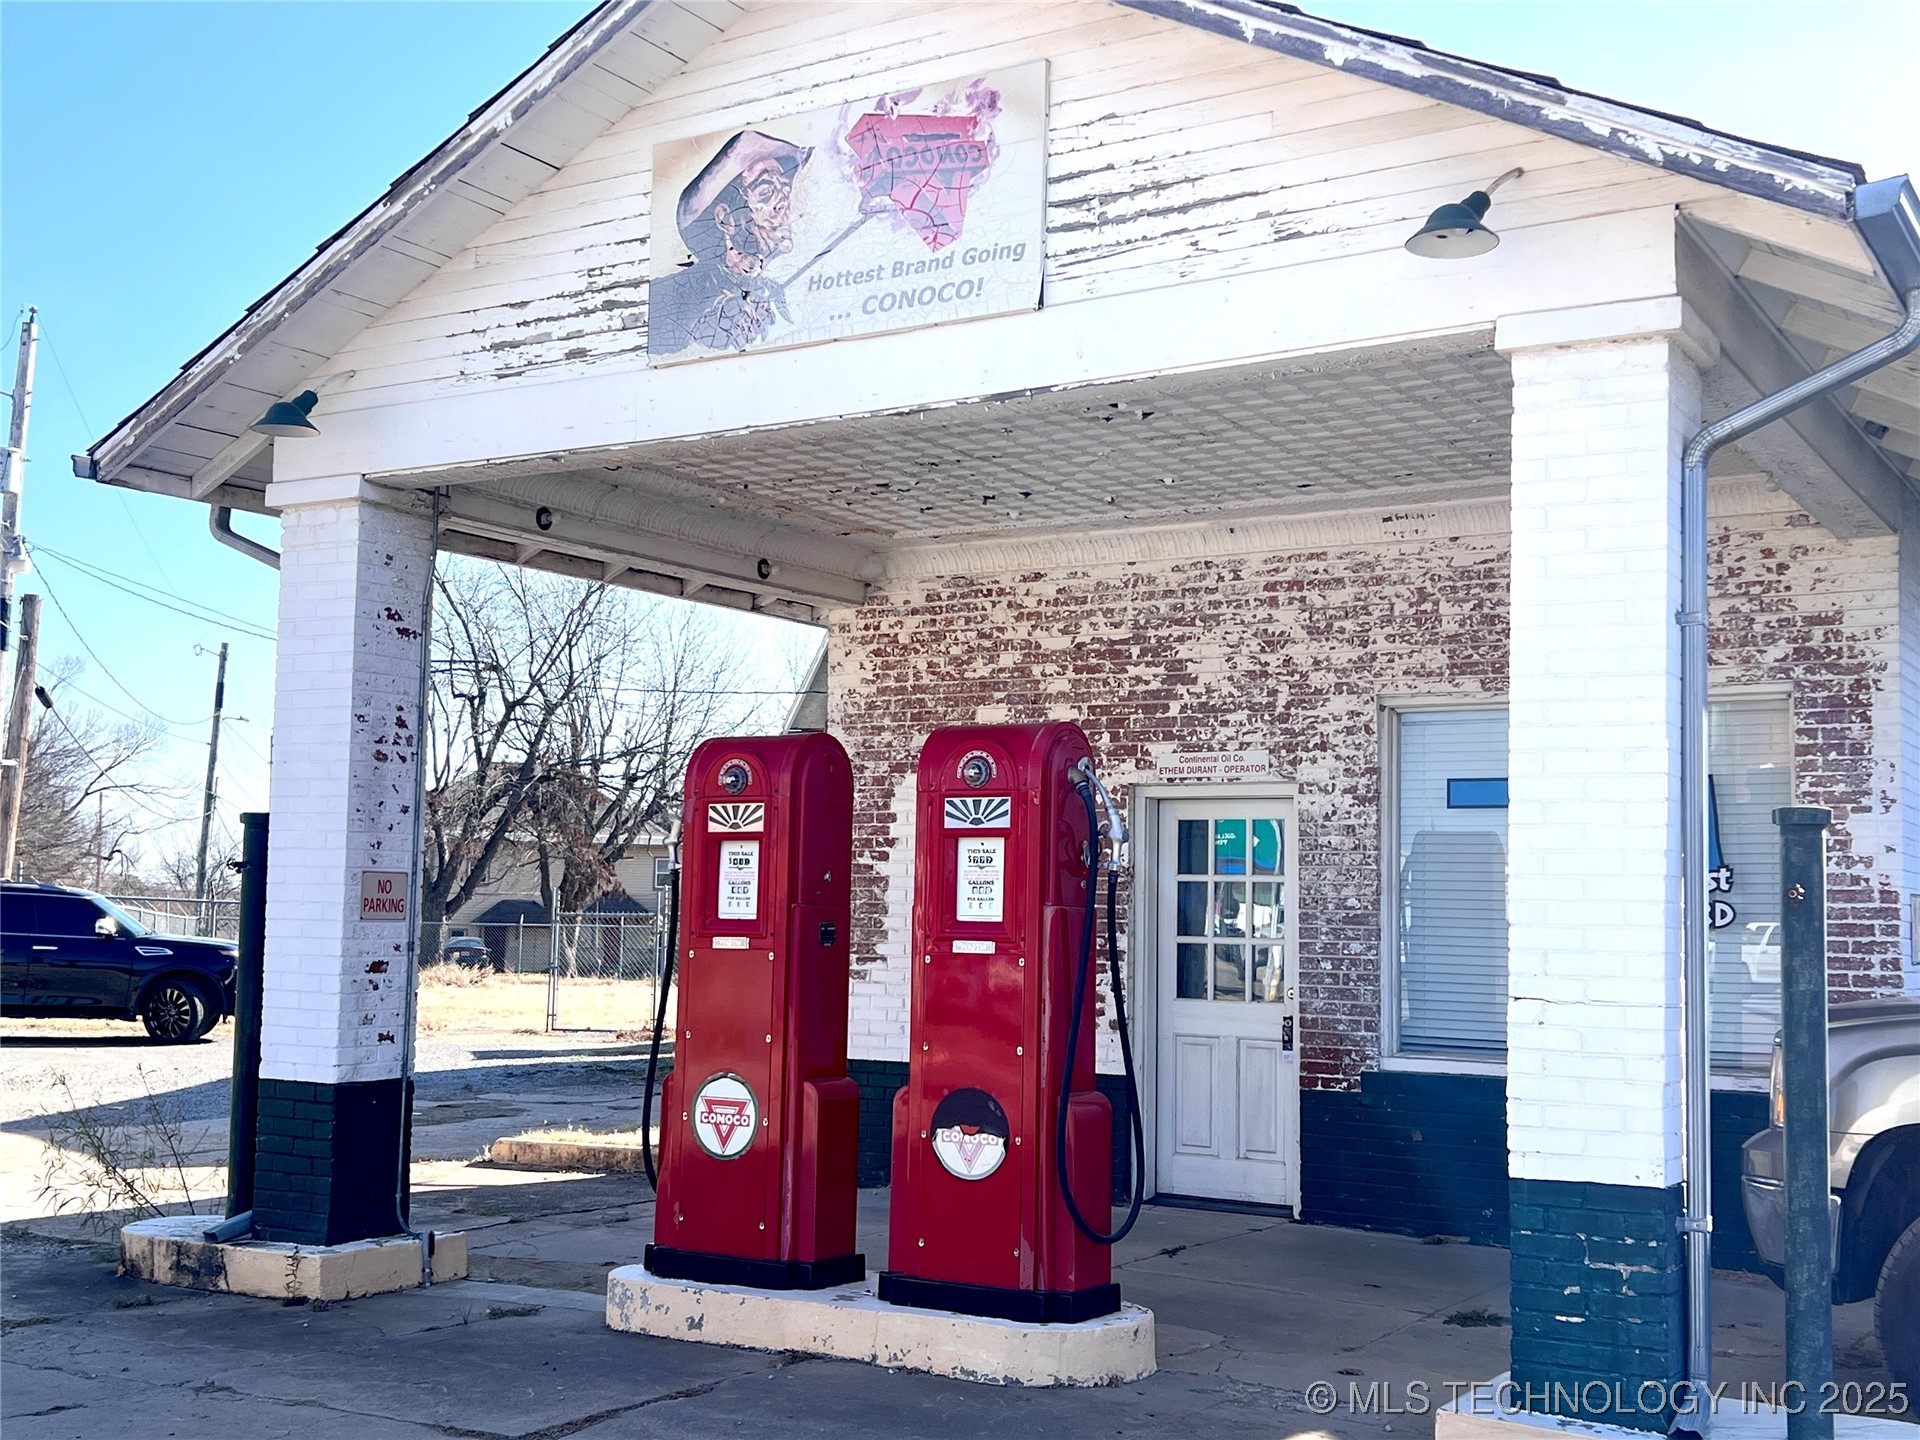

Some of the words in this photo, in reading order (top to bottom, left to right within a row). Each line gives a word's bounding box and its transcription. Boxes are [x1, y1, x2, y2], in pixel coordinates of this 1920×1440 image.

[807, 265, 884, 292] Hottest
[891, 252, 954, 277] Brand
[961, 241, 1026, 268] Going
[861, 277, 985, 317] CONOCO!
[1179, 755, 1219, 764] Continental
[1221, 754, 1231, 762] Oil
[1233, 754, 1245, 762] Co.
[1159, 766, 1184, 775] ETHEM
[1187, 765, 1217, 774] DURANT
[1224, 764, 1266, 774] OPERATOR
[378, 879, 392, 894] NO
[363, 897, 404, 913] PARKING
[701, 1112, 750, 1126] CONOCO
